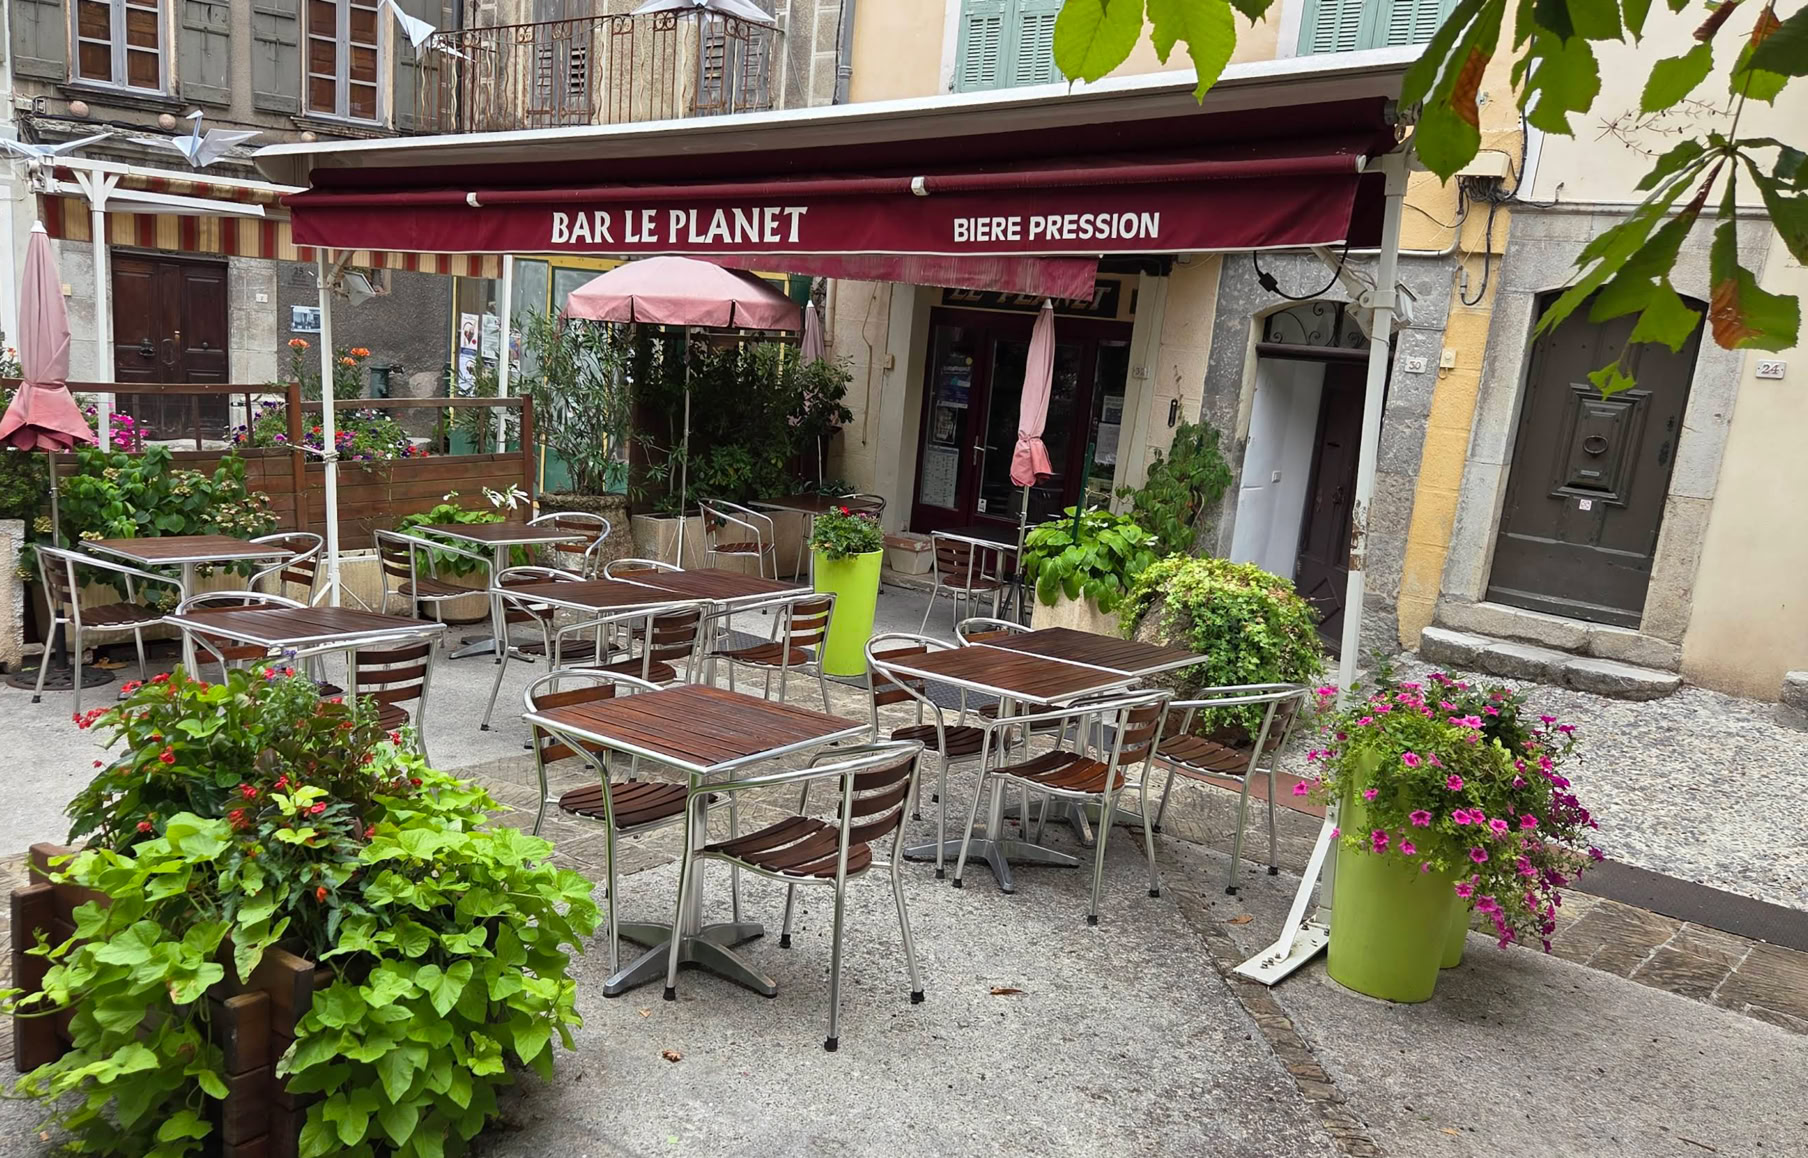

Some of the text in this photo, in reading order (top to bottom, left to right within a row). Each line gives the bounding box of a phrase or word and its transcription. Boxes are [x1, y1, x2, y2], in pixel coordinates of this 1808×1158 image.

[551, 206, 808, 243] BAR LE PLANET
[954, 212, 1160, 242] BIERE PRESSION
[1408, 361, 1421, 370] 30
[1761, 364, 1780, 374] 24
